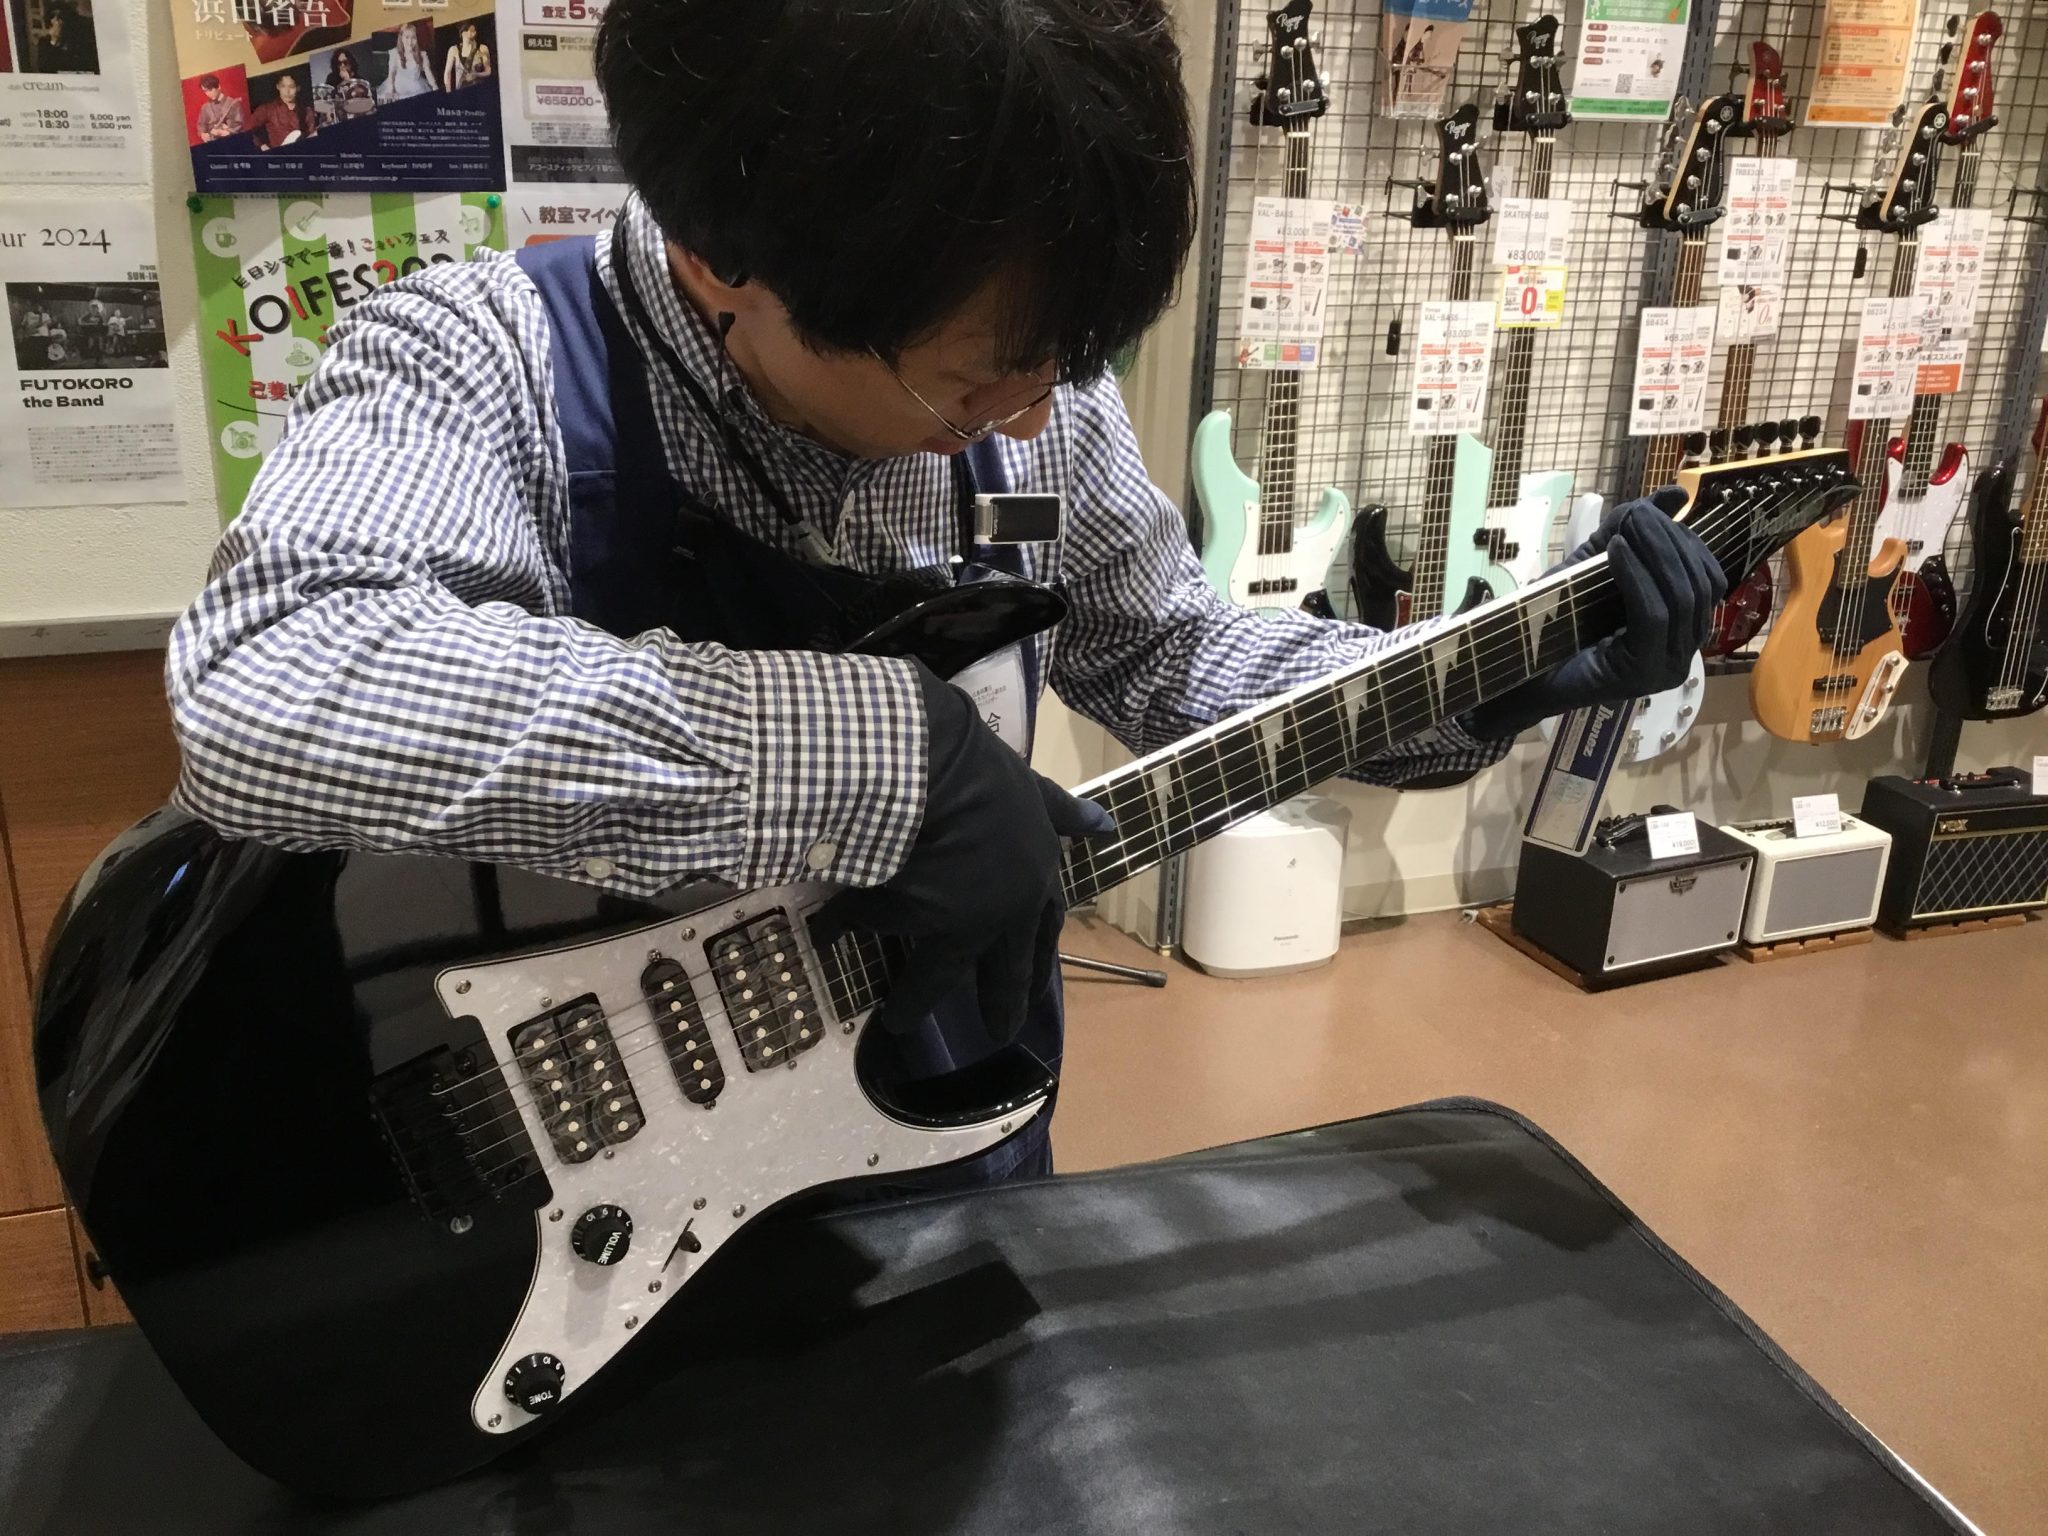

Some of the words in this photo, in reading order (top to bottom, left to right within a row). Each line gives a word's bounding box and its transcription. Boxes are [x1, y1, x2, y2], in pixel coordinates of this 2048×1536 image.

[196, 30, 253, 41] トリビュート
[37, 109, 68, 119] 18:00
[38, 119, 70, 129] 18:30
[0, 231, 26, 247] ur
[40, 228, 111, 254] 2024
[20, 377, 134, 391] FUTOKORO
[22, 396, 53, 409] the
[56, 395, 105, 408] Band
[1582, 703, 1616, 758] Ibanez
[597, 1232, 623, 1265] VOLUME
[528, 1390, 554, 1406] TONE
